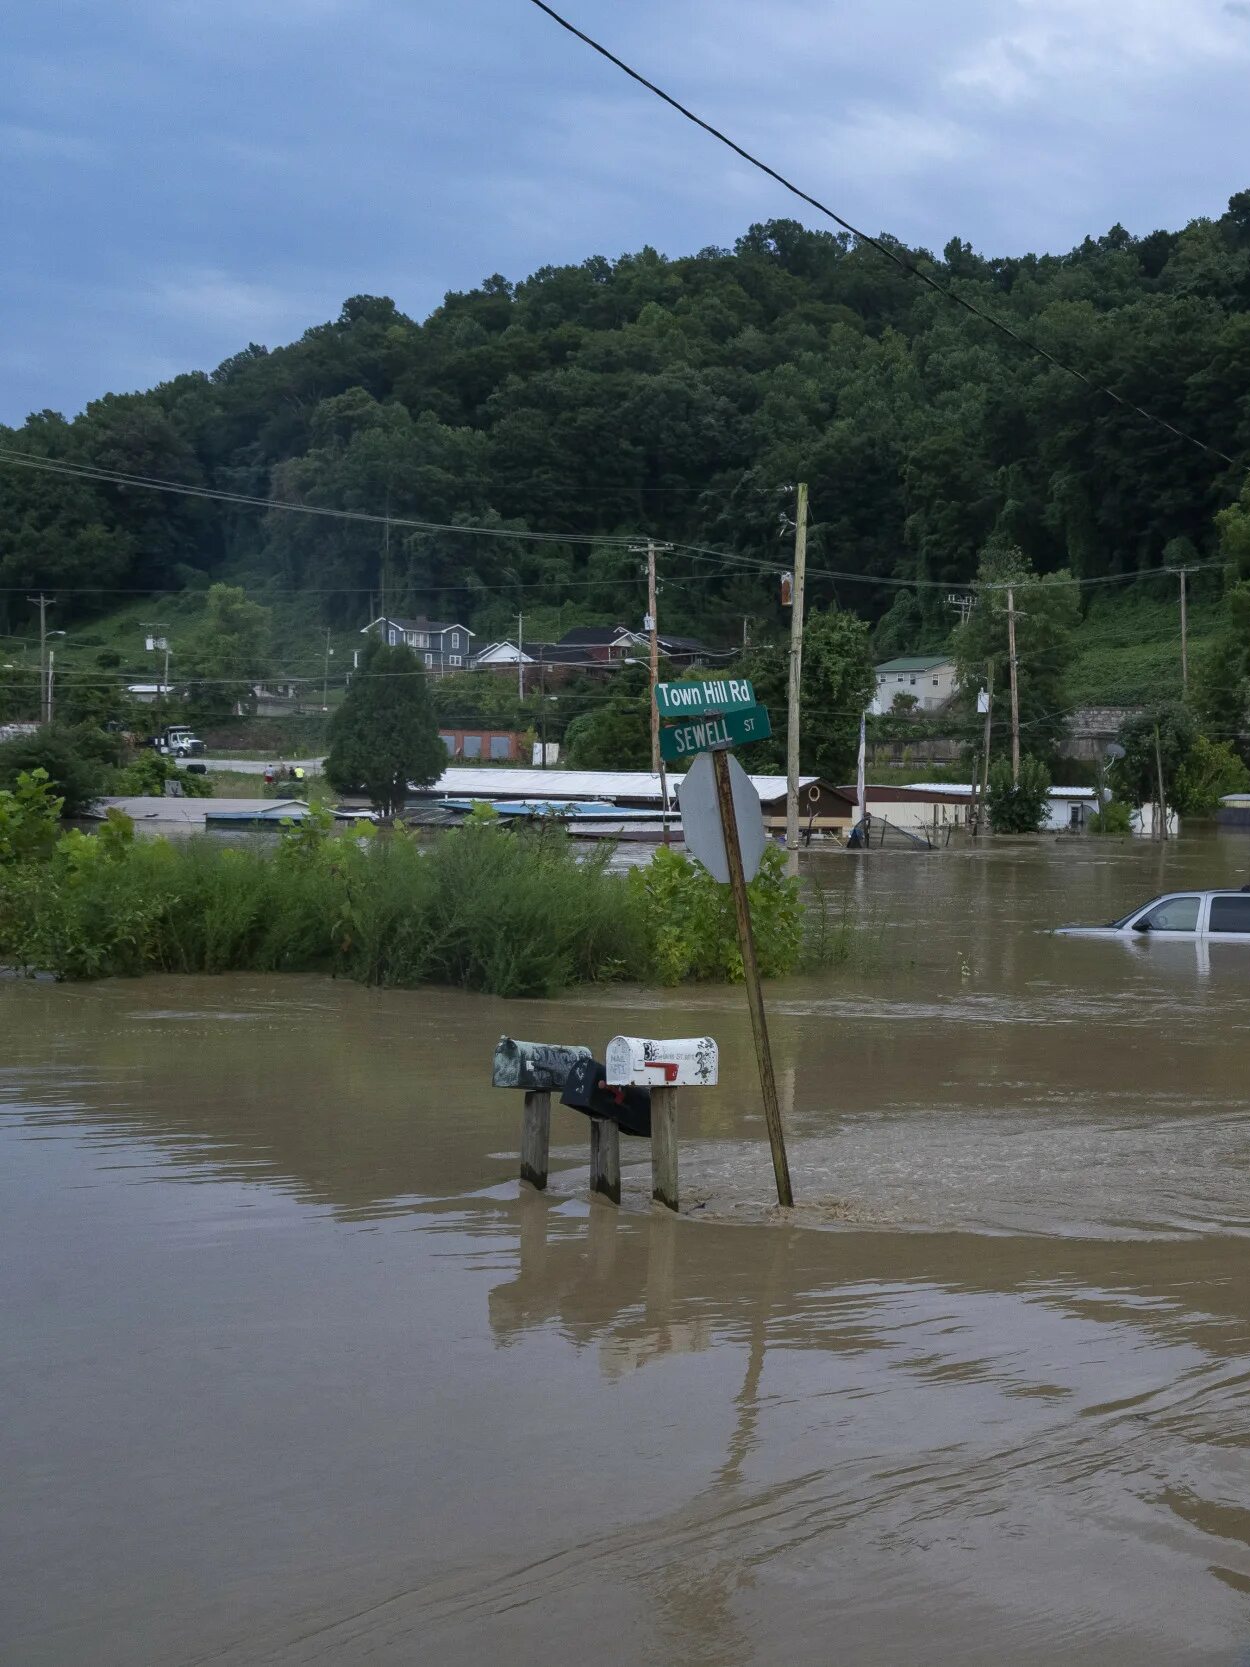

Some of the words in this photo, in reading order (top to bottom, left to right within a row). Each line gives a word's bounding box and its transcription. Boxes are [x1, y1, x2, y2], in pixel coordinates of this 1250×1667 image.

[658, 683, 702, 707] Town
[702, 680, 729, 704] Hill
[728, 679, 751, 703] Rd
[674, 719, 733, 753] SEWELL
[743, 718, 755, 732] ST
